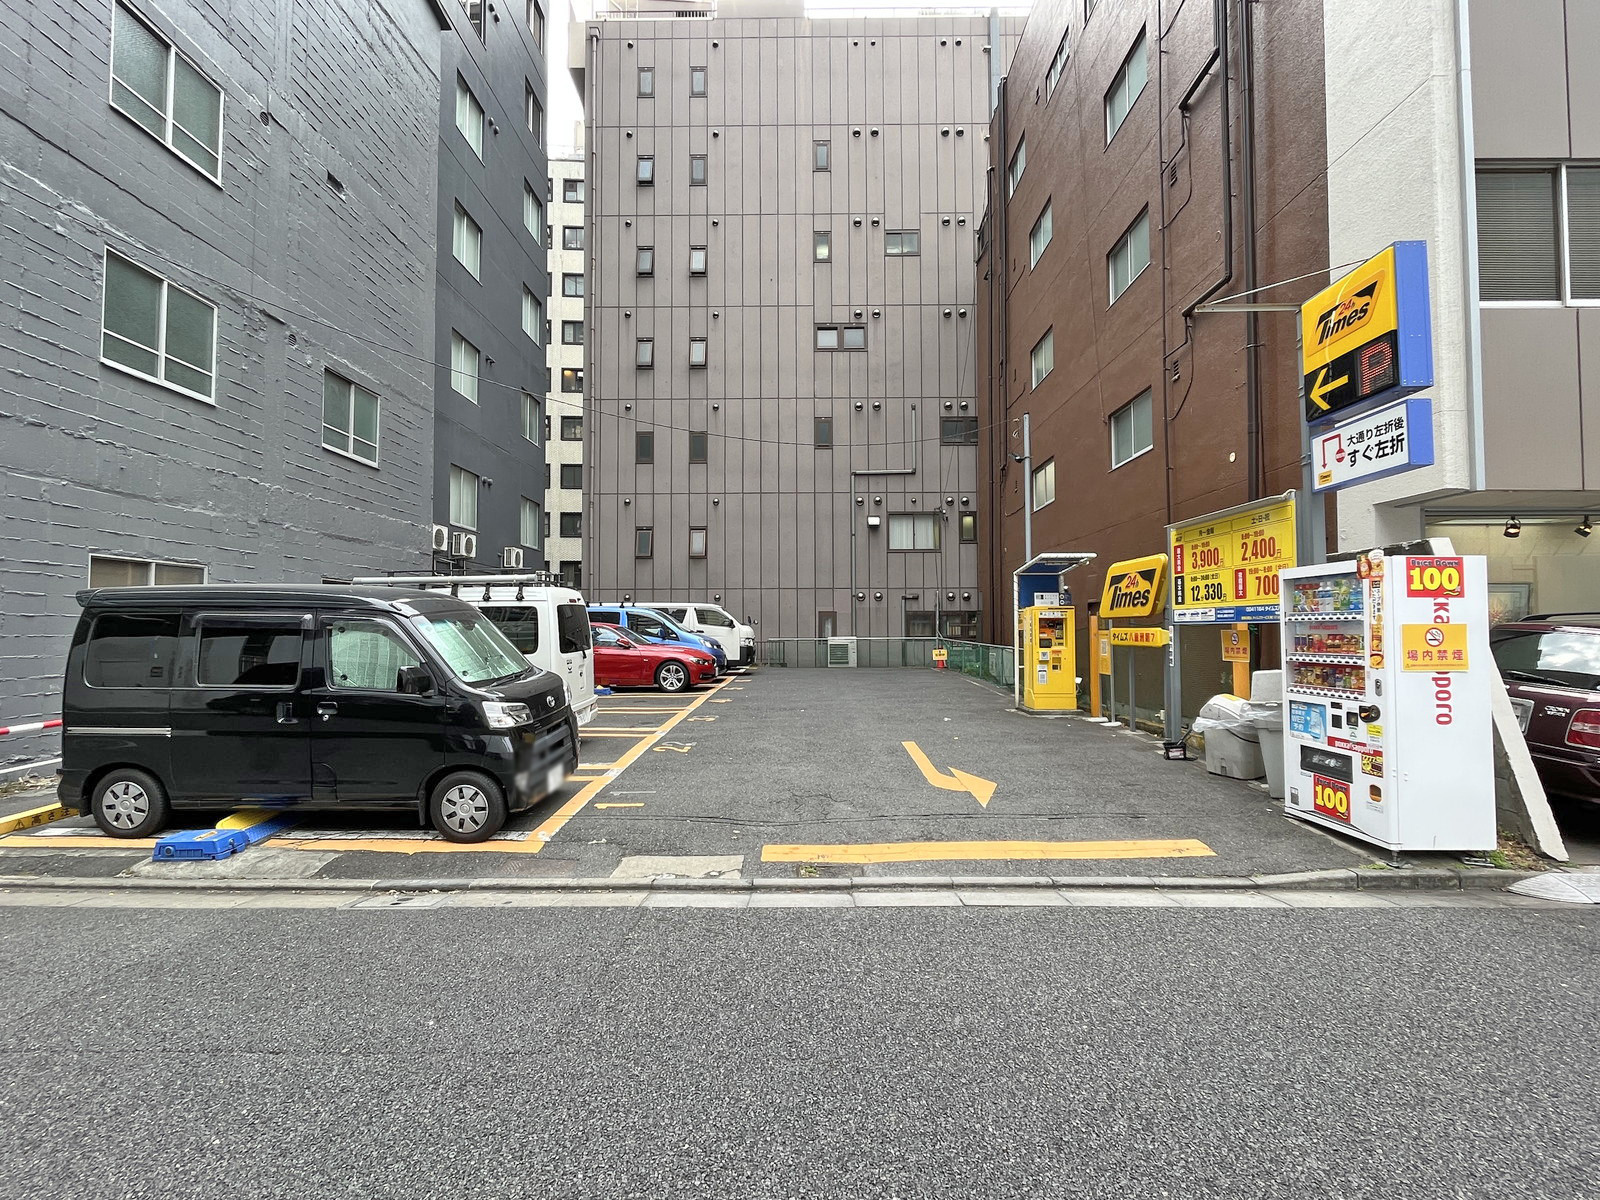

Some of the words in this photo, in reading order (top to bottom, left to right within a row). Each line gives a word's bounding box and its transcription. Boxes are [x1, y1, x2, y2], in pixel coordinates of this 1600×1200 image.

[1315, 300, 1371, 346] Times
[1361, 341, 1393, 396] P
[1347, 416, 1404, 447] 大通り左折後
[1347, 432, 1405, 468] すぐ左折
[1410, 559, 1433, 567] PRICE
[1255, 574, 1279, 596] 700
[1410, 567, 1460, 591] 100
[1109, 583, 1151, 611] Times
[1407, 649, 1464, 662] 場内禁煙
[1315, 784, 1348, 814] 100
